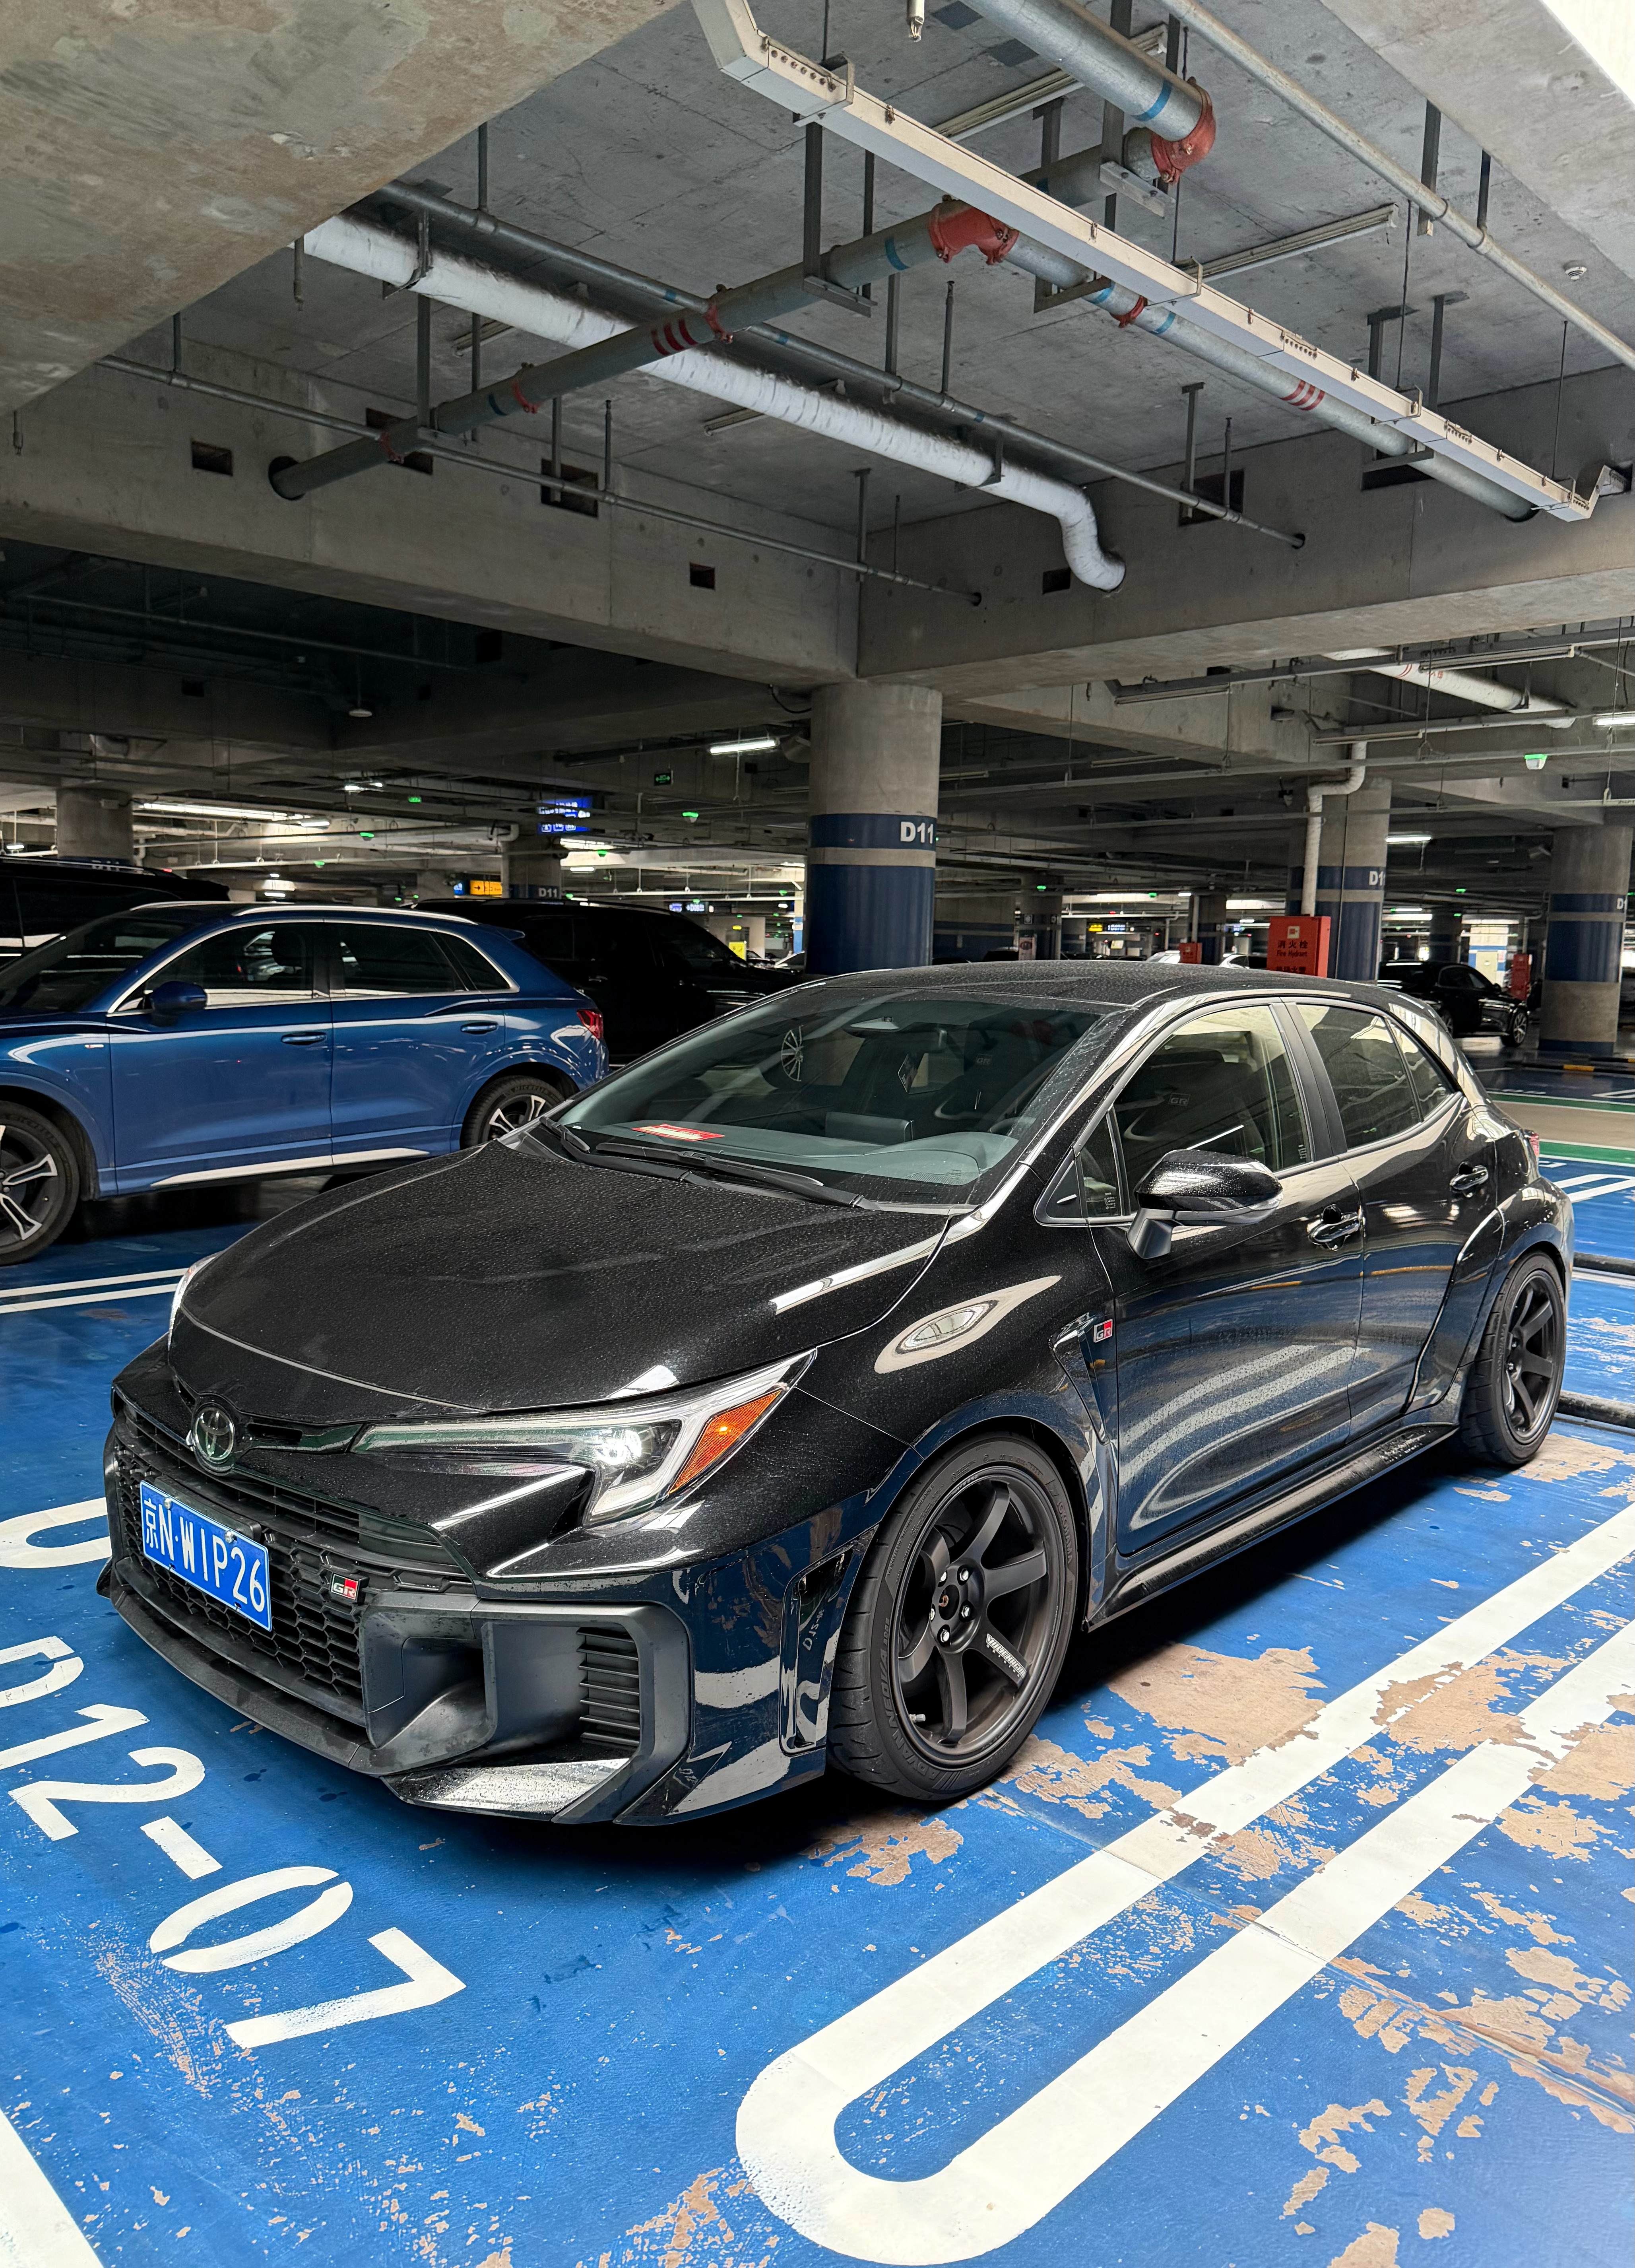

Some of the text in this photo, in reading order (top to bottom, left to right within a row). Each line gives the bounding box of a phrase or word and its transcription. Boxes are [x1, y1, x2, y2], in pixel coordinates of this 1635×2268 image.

[900, 821, 933, 844] D11
[538, 887, 557, 898] D11
[1278, 940, 1308, 949] 消火栓
[1097, 1327, 1111, 1340] GR
[1057, 1501, 1073, 1565] YOKOHAMA
[334, 1583, 355, 1598] GR
[986, 1634, 1009, 1657] VOLK
[880, 1648, 898, 1728] NEOVA
[892, 1728, 941, 1780] ADVAN
